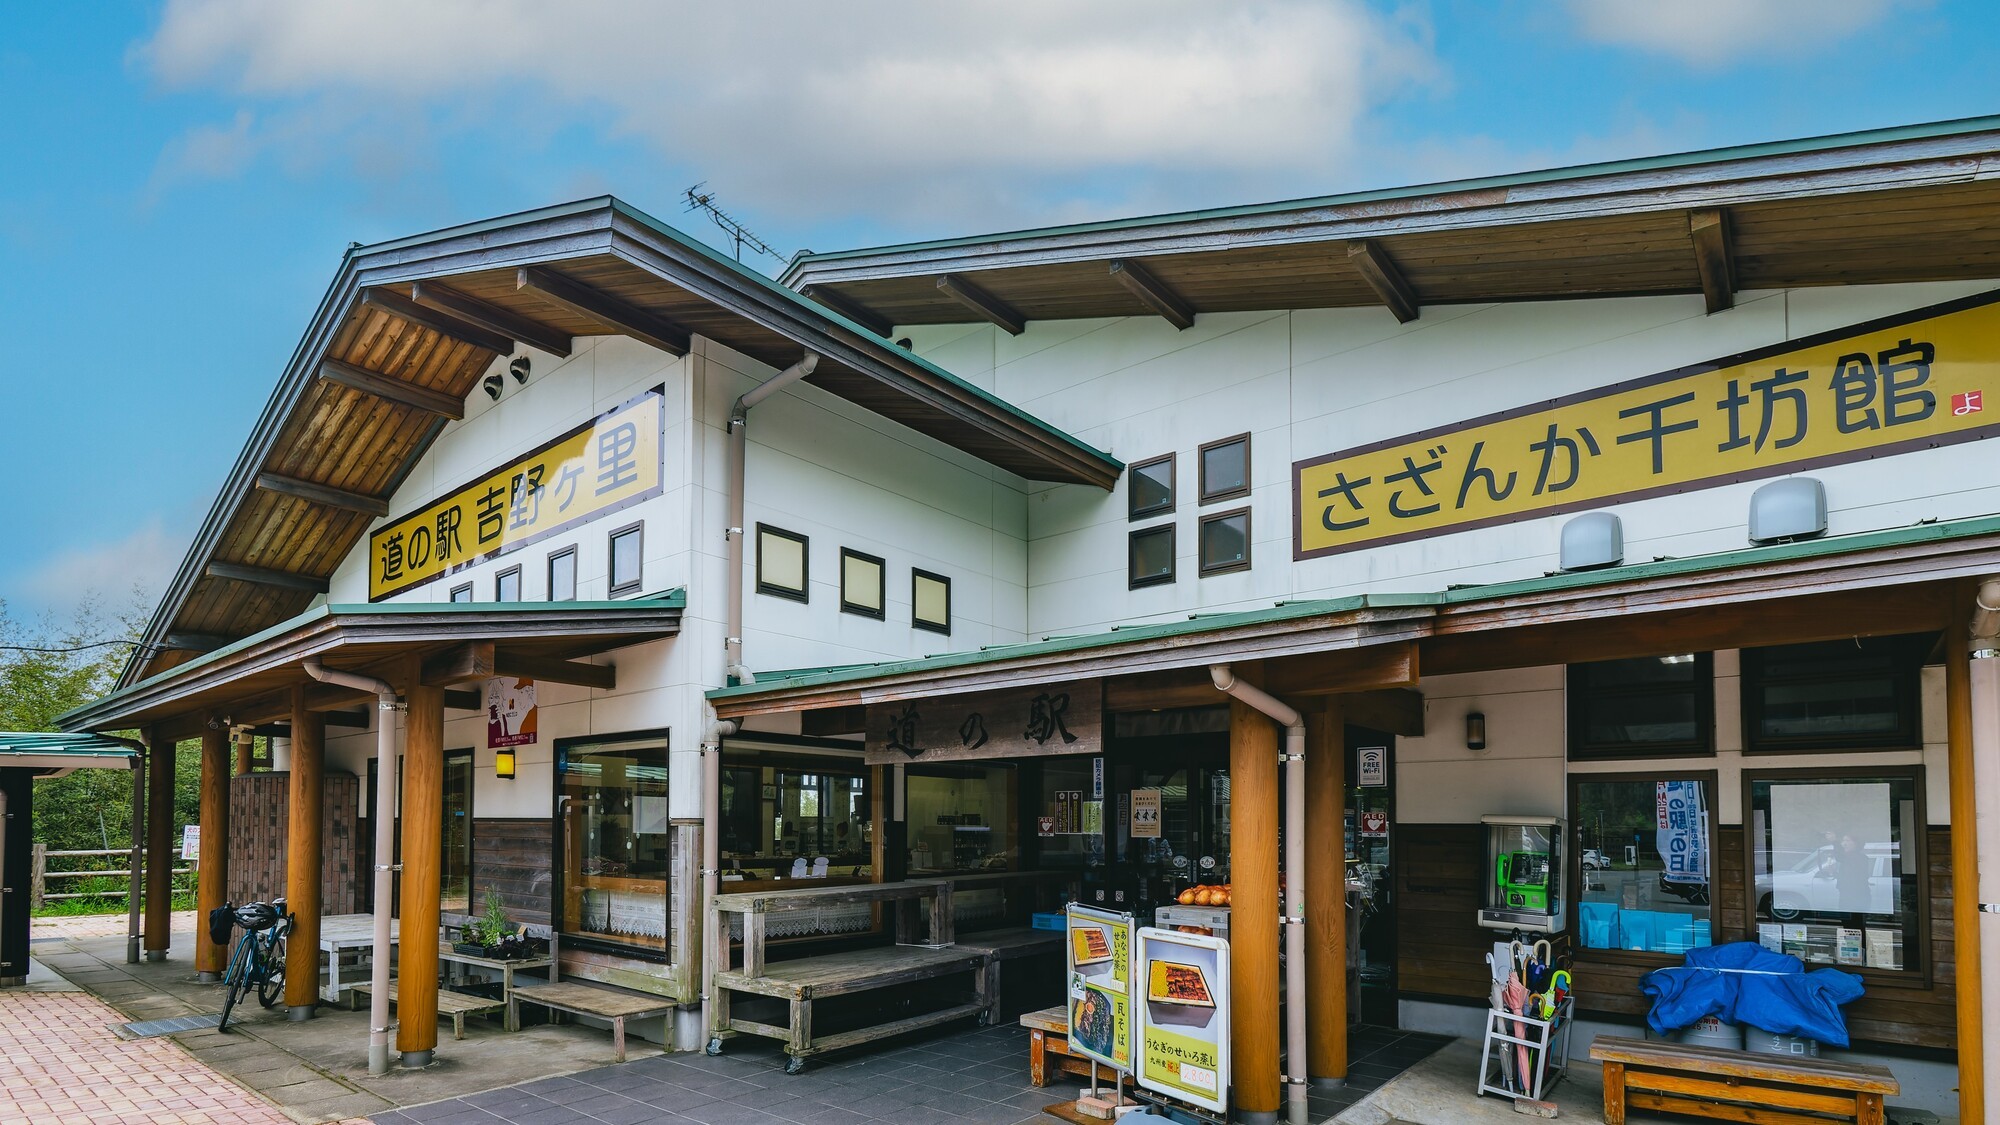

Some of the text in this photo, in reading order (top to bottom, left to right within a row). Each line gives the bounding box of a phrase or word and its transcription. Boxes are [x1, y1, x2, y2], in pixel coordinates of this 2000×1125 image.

[381, 504, 462, 584] 道の駅
[886, 692, 1079, 759] 道の駅
[1117, 1002, 1125, 1046] 瓦そば
[1146, 1038, 1217, 1067] うなぎのせいろ蒸し
